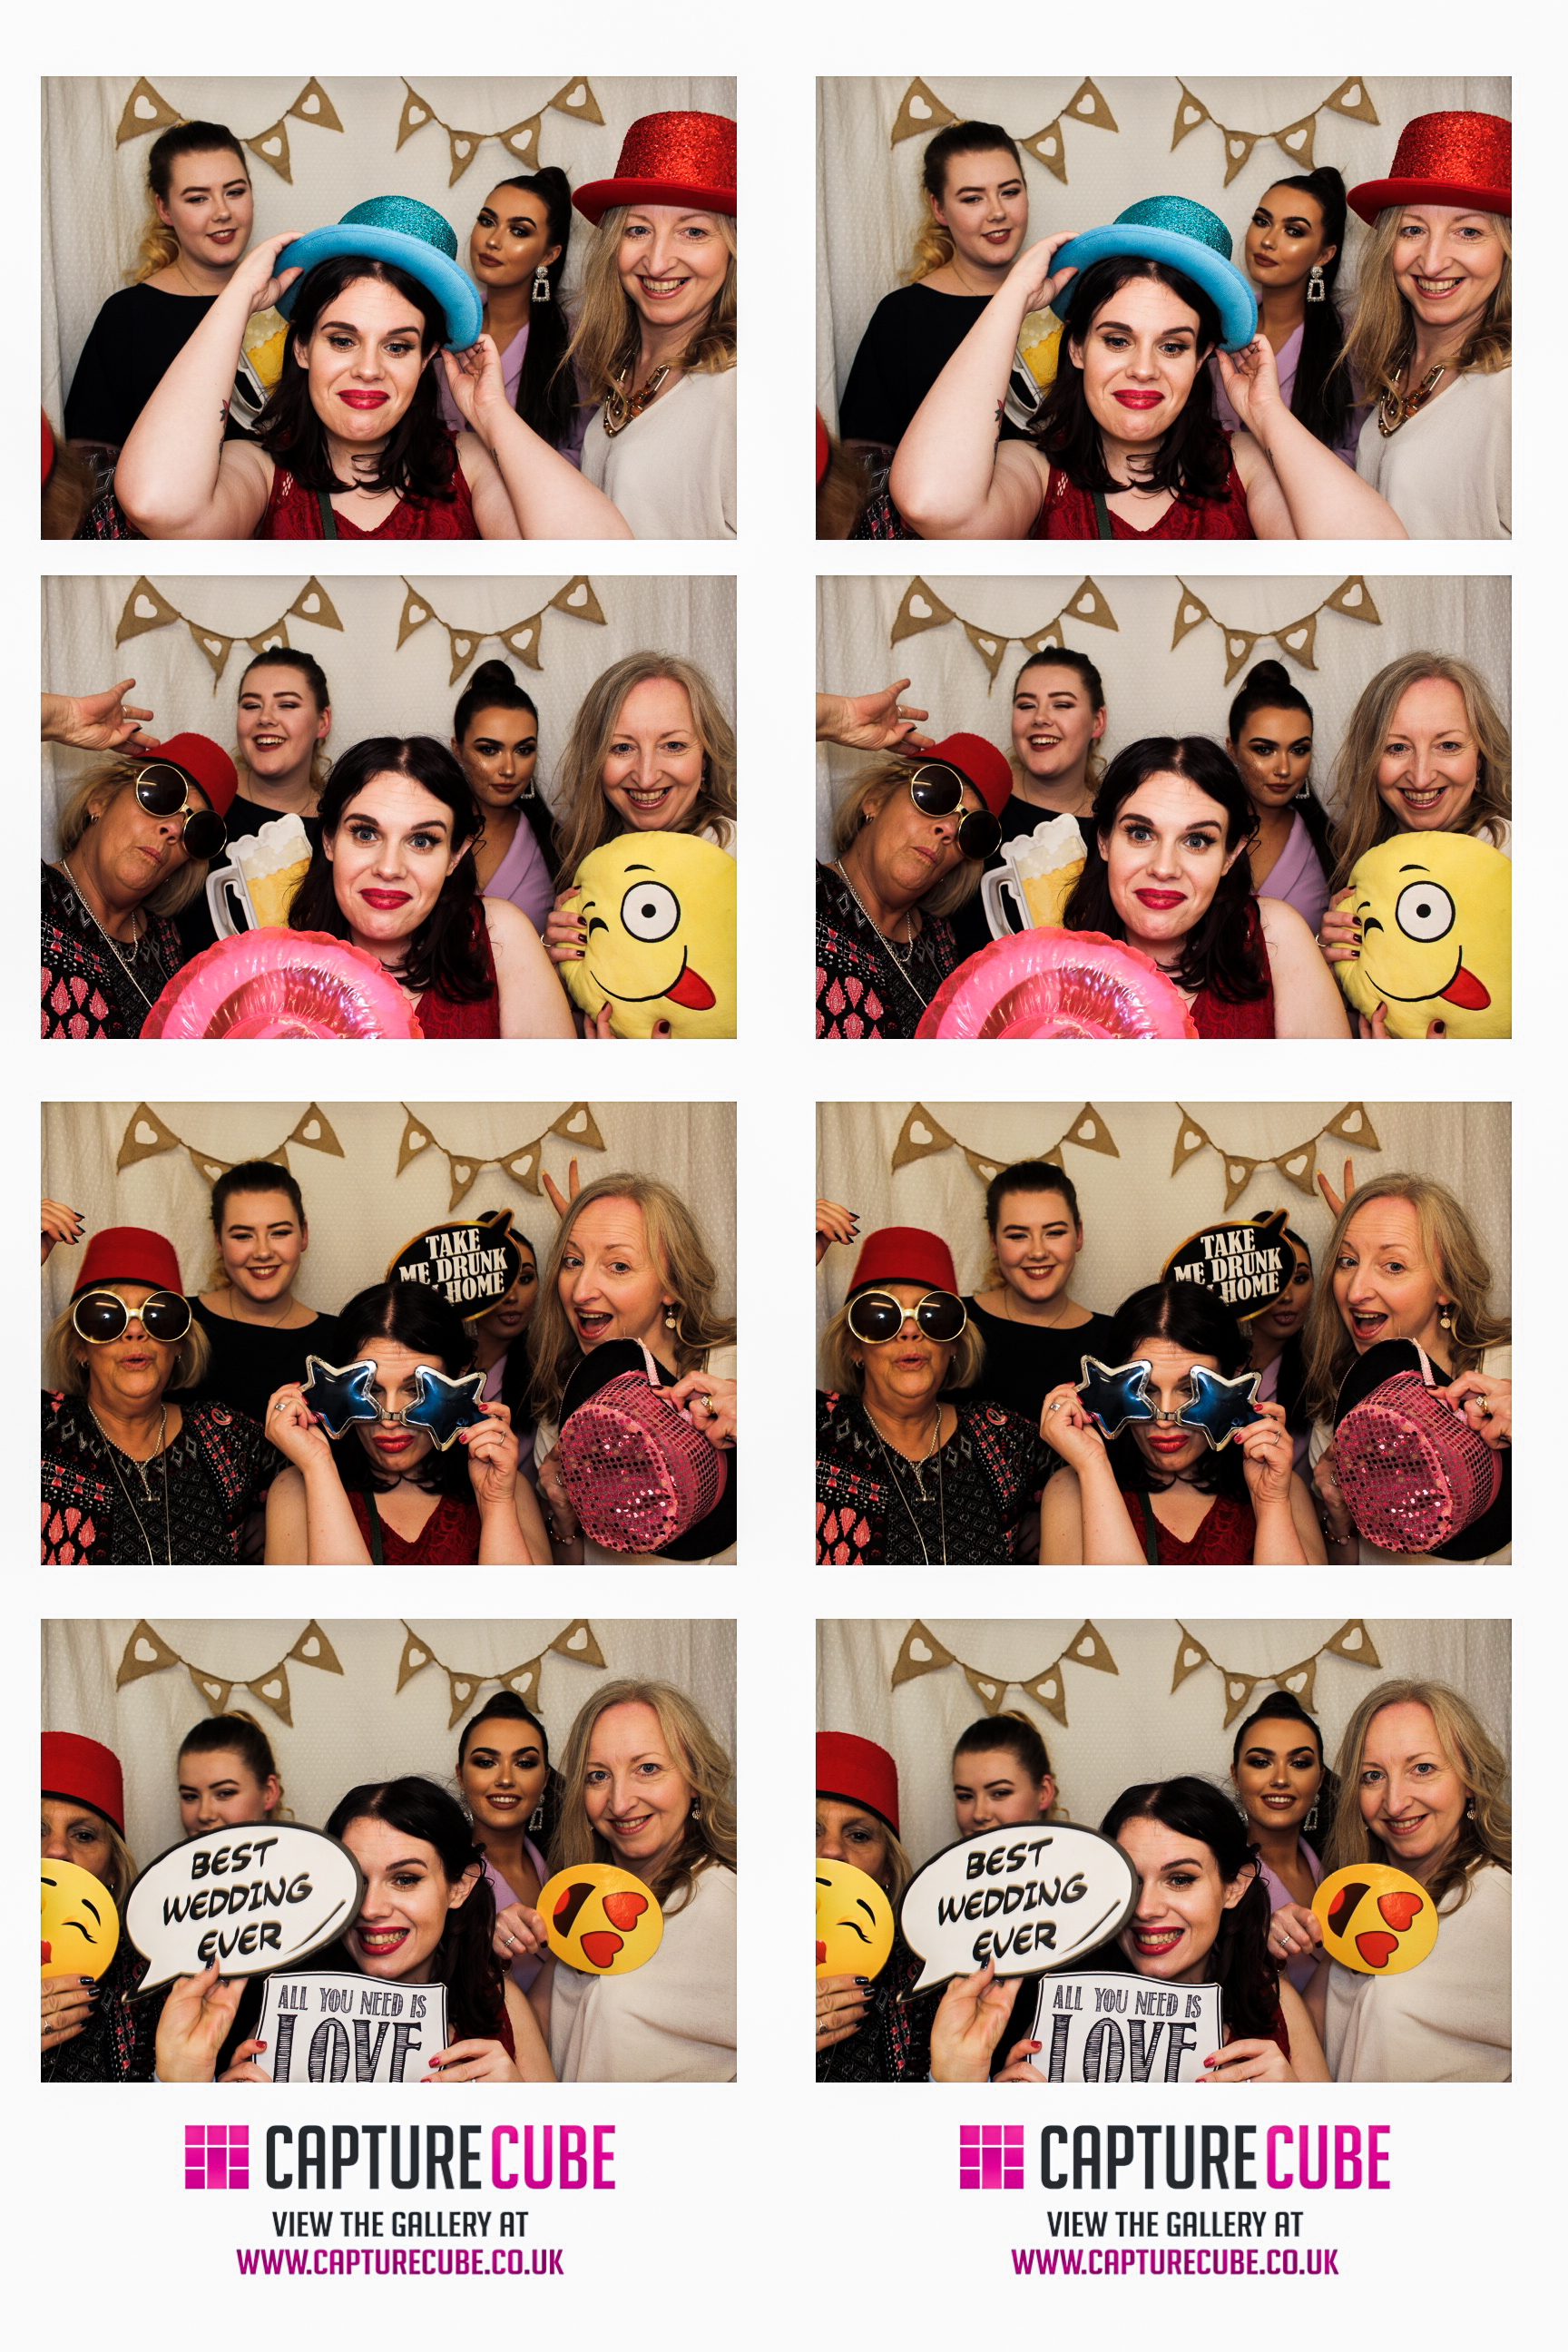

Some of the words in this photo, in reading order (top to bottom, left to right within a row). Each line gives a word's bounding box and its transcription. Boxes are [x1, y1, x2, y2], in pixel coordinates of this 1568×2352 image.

[426, 1228, 481, 1259] TAKE
[1200, 1228, 1256, 1259] TAKE
[399, 1262, 431, 1285] ME
[436, 1247, 508, 1282] DRUNK
[1174, 1262, 1206, 1285] ME
[1211, 1247, 1283, 1282] DRUNK
[446, 1271, 505, 1304] HOME
[1220, 1271, 1279, 1304] HOME
[191, 1837, 279, 1879] BEST
[966, 1837, 1054, 1879] BEST
[163, 1872, 313, 1926] WEDDING
[938, 1872, 1088, 1926] WEDDING
[198, 1920, 282, 1962] EVER
[973, 1920, 1057, 1962] EVER
[278, 1984, 309, 2011] ALL
[319, 1987, 354, 2014] YOU
[360, 1991, 404, 2017] NEED
[409, 1994, 427, 2018] IS
[1053, 1984, 1083, 2011] ALL
[1094, 1987, 1129, 2014] YOU
[1135, 1991, 1179, 2017] NEED
[1184, 1994, 1202, 2018] IS
